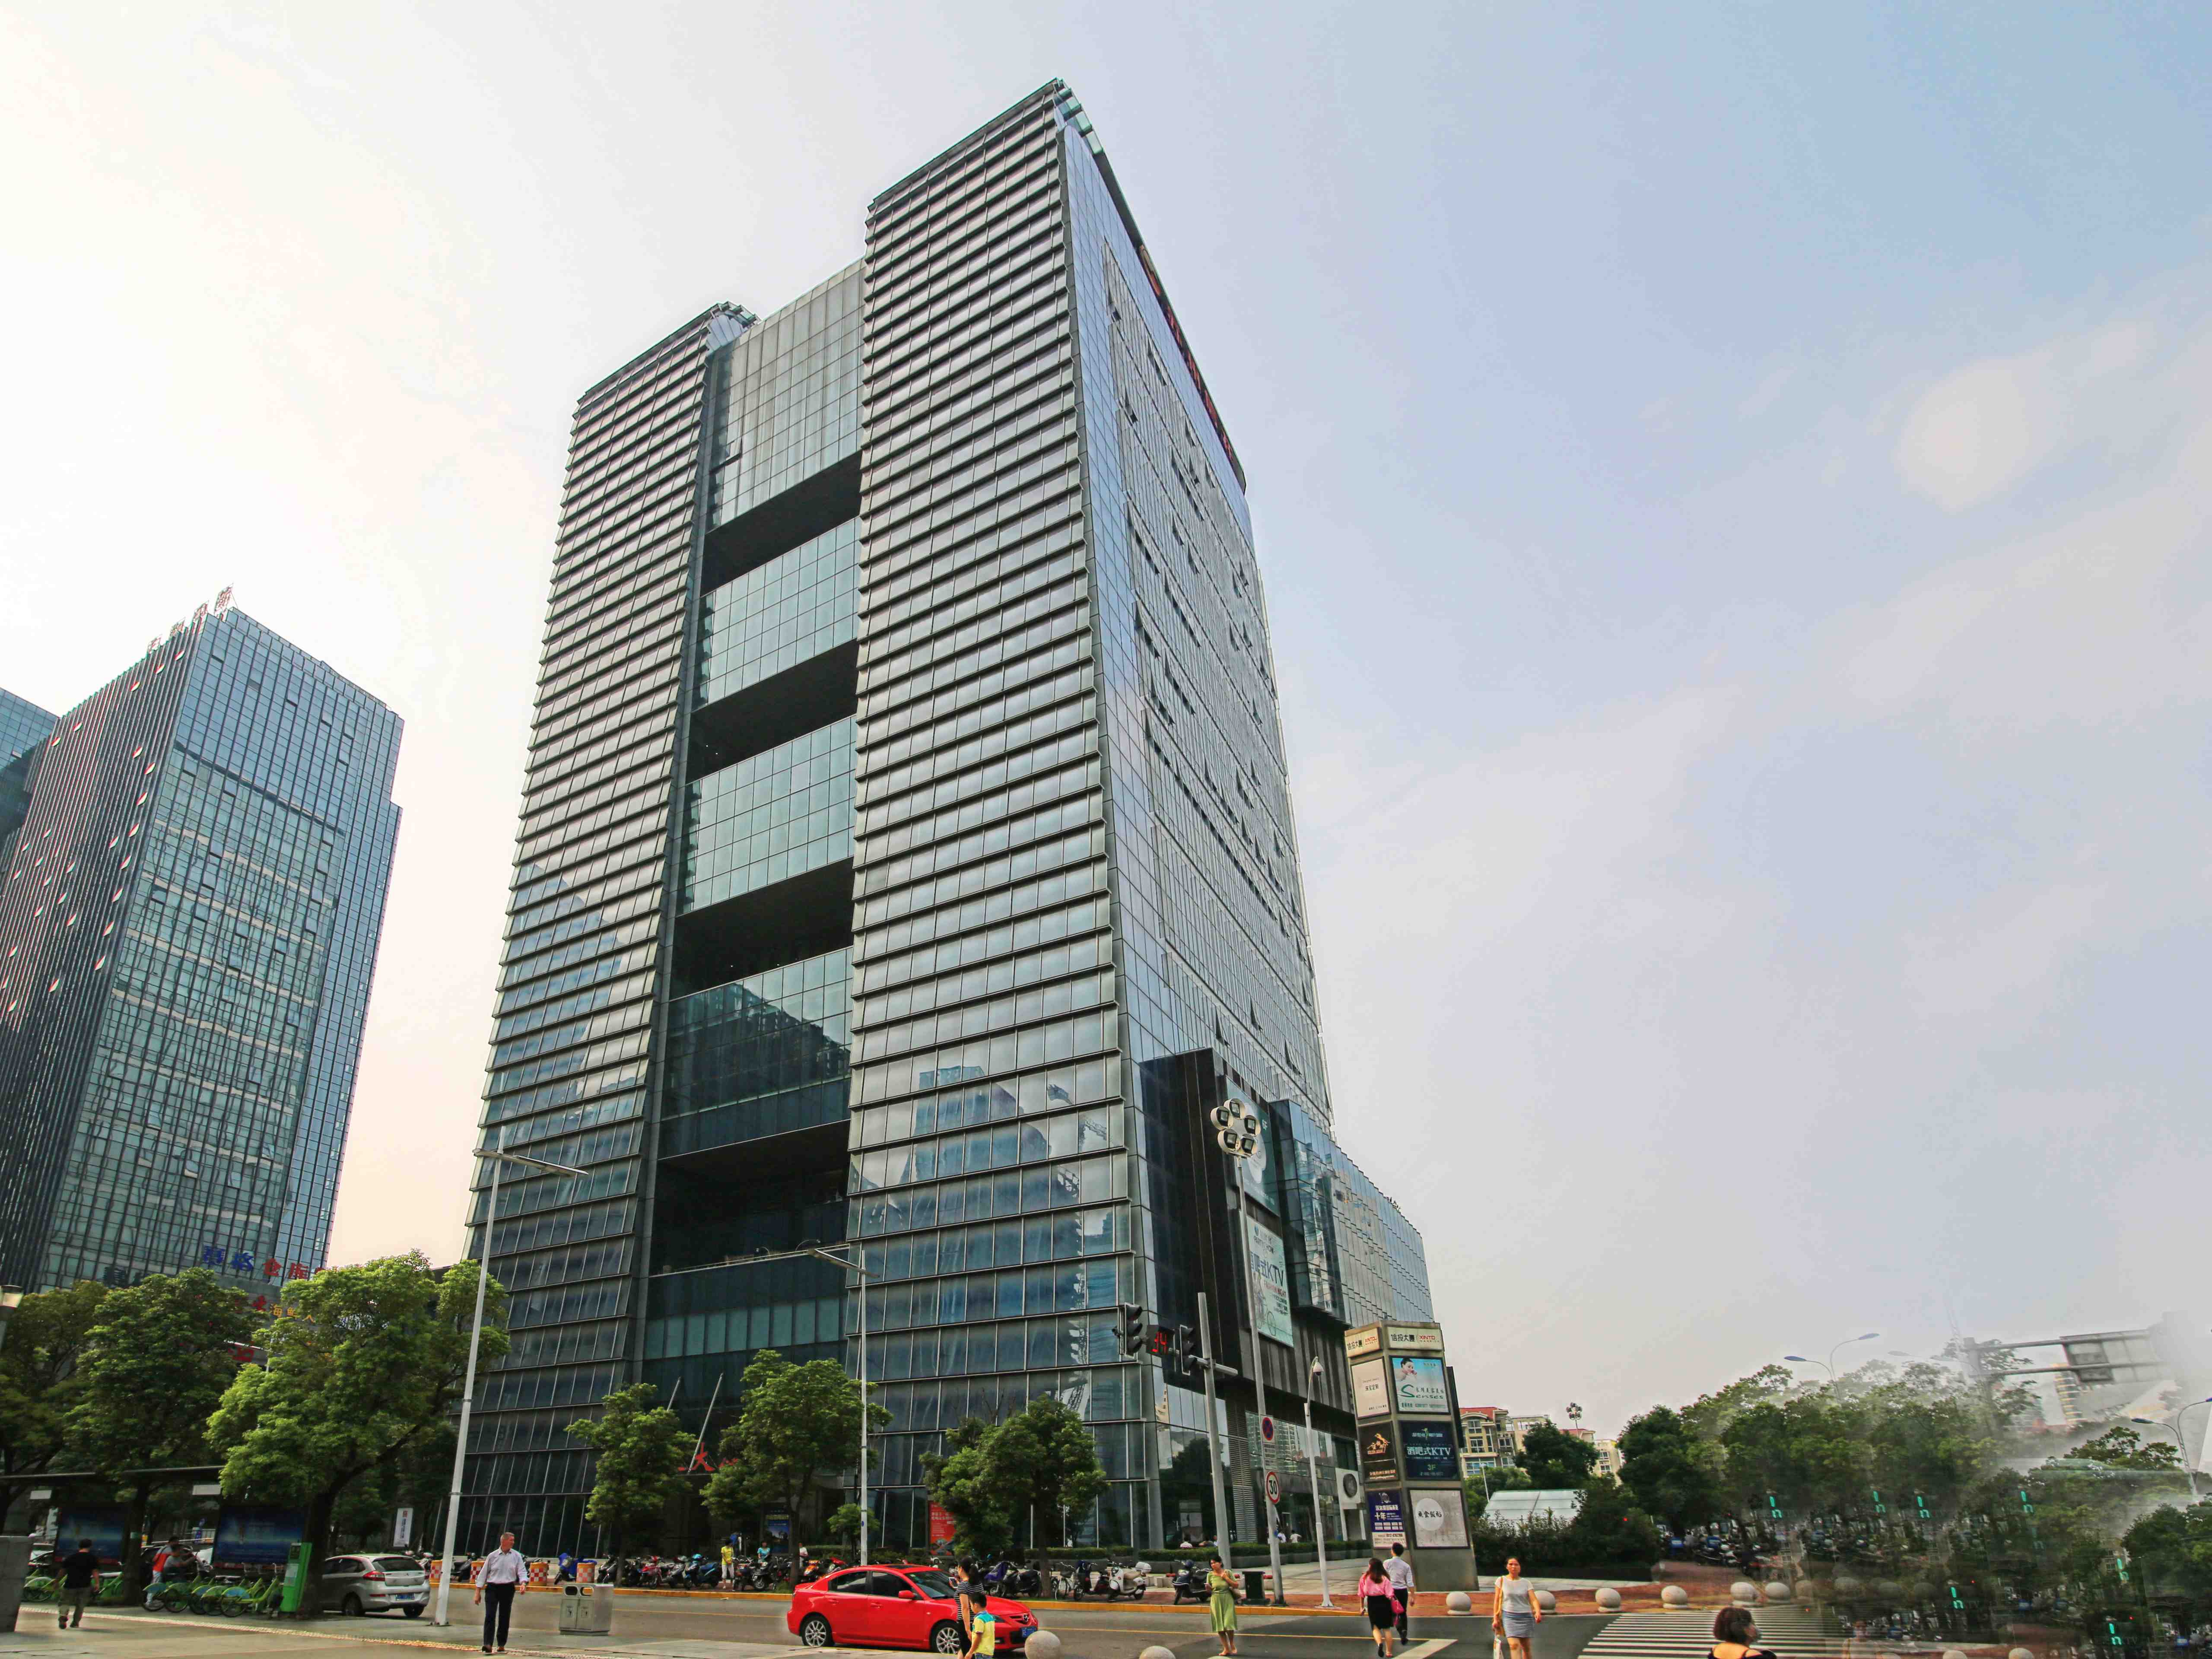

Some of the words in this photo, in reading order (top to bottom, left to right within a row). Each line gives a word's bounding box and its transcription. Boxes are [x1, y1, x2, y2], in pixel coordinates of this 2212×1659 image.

[1399, 1384, 1443, 1399] Senses
[1407, 1446, 1451, 1456] 酒吧式KTV
[1269, 1480, 1278, 1495] 30
